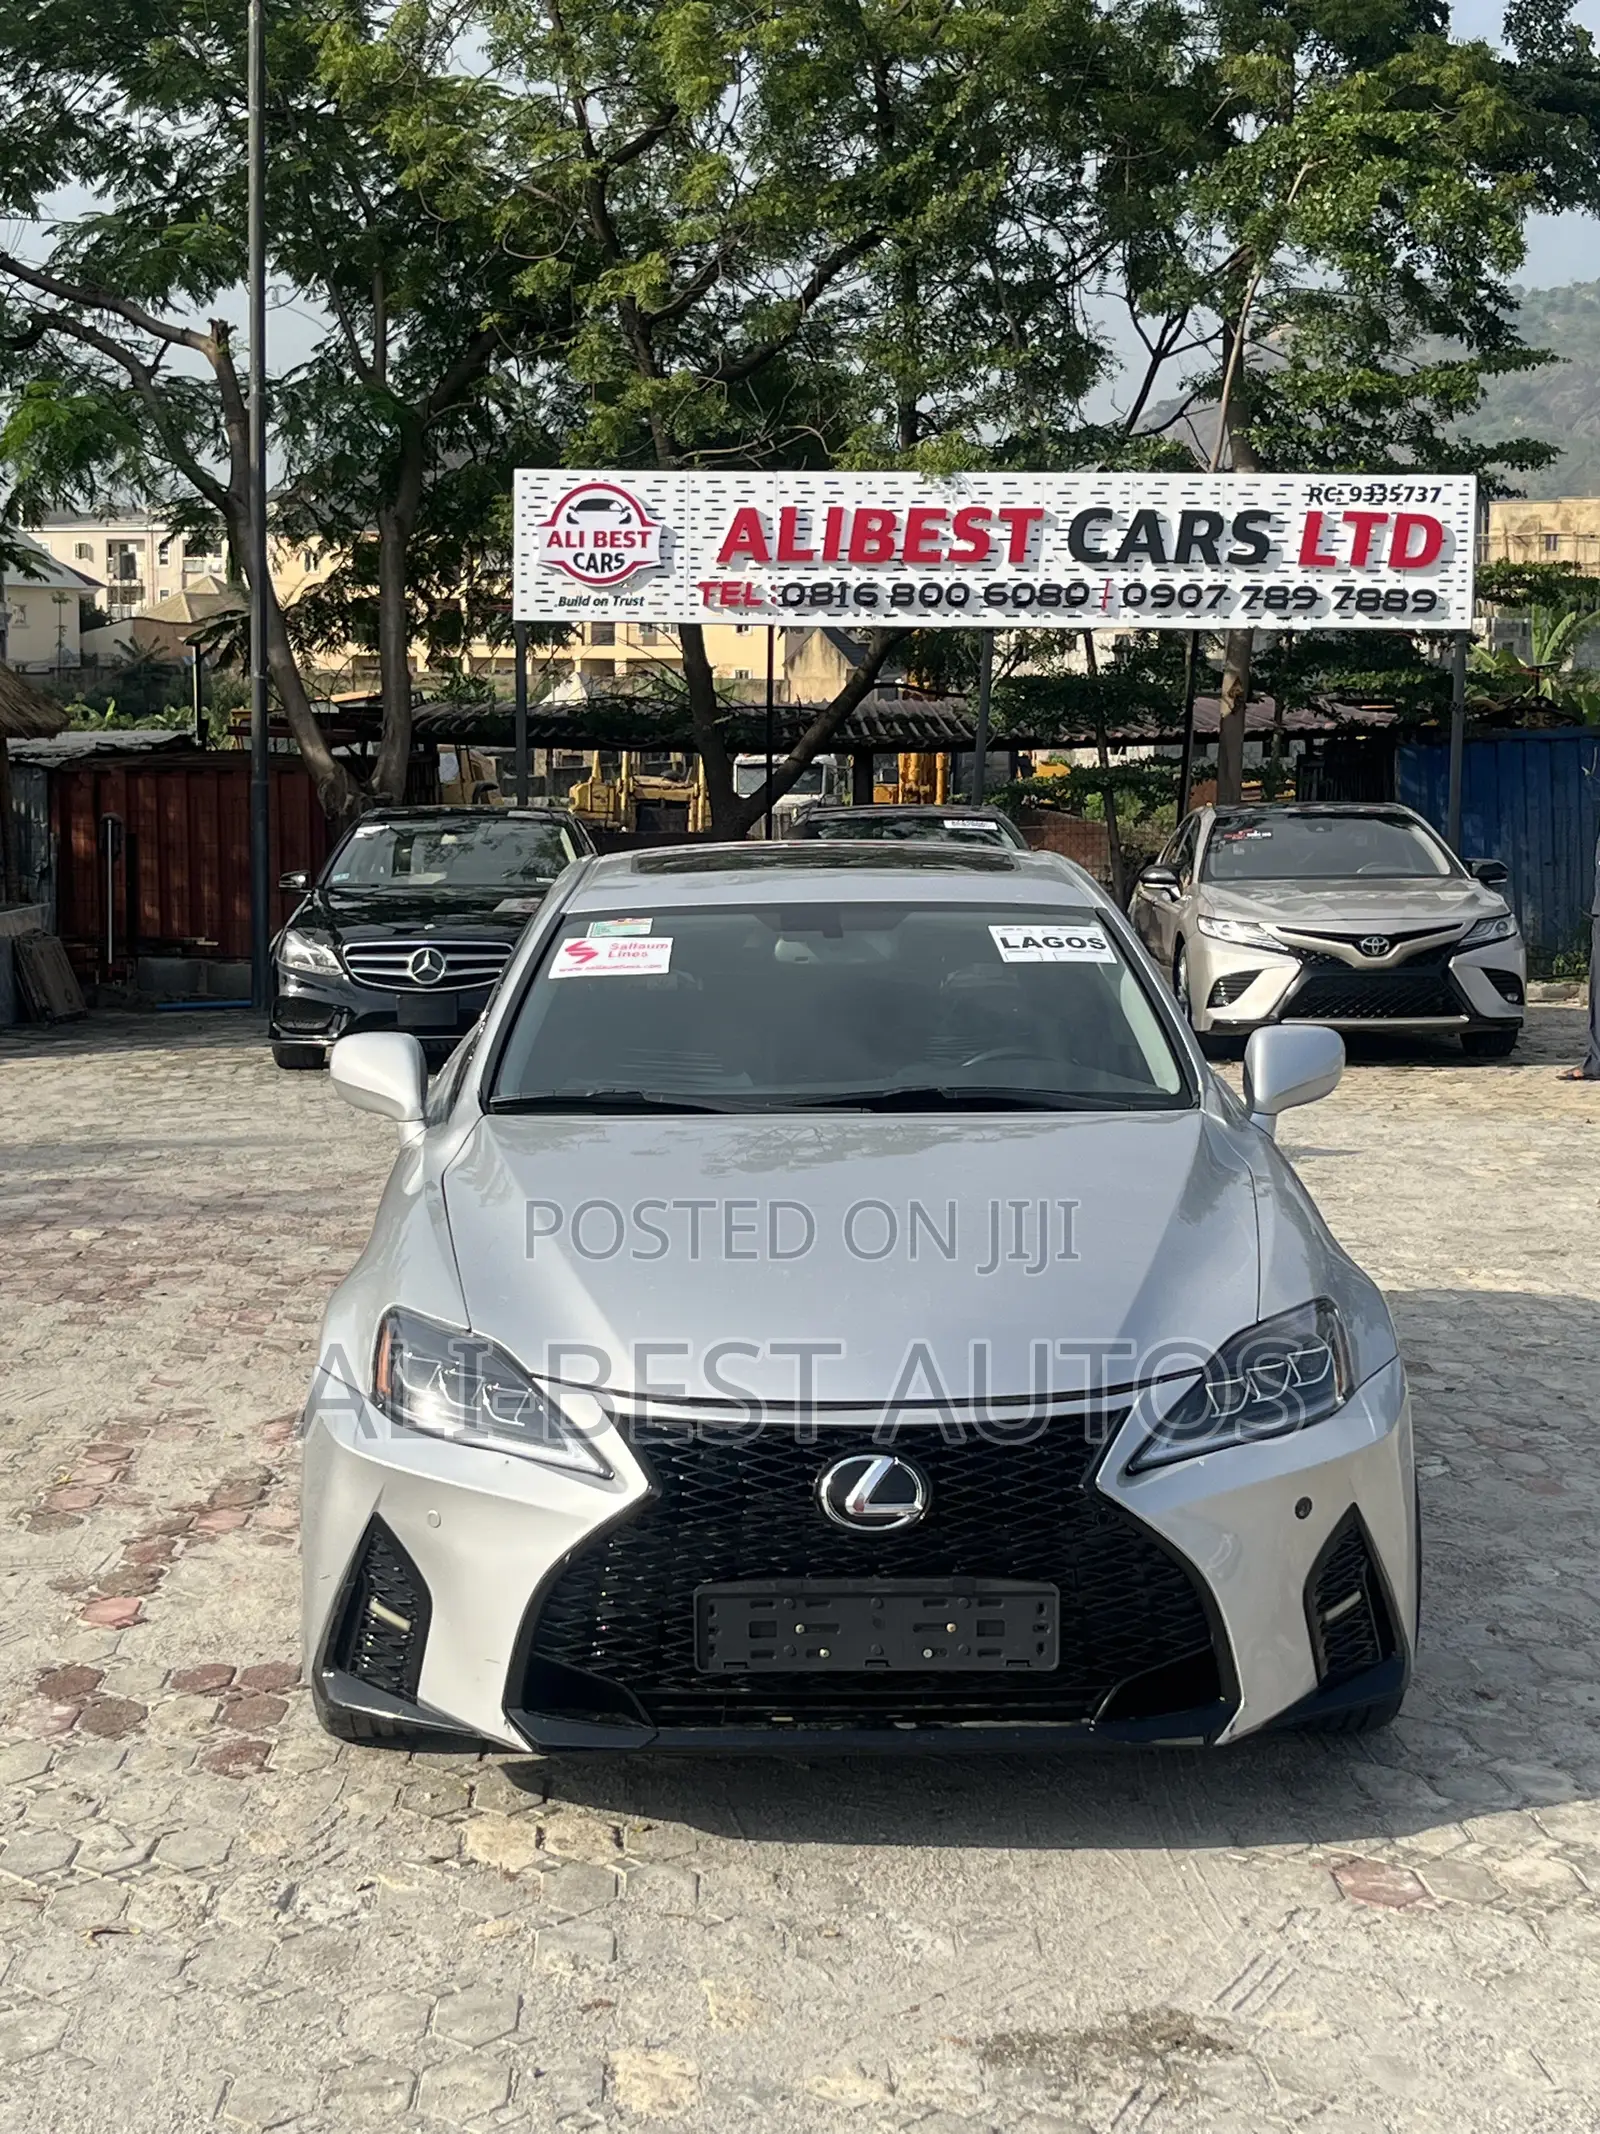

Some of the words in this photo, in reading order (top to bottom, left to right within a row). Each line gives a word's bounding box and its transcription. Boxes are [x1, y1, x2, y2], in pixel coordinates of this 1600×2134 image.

[1349, 486, 1442, 503] 9335737
[546, 530, 585, 549] ALI
[593, 530, 652, 549] BEST
[716, 506, 1044, 563] ALIBEST
[1068, 507, 1271, 565] CARS
[1298, 511, 1444, 568] LTD
[572, 552, 626, 574] CARS
[558, 596, 591, 607] Build
[594, 598, 609, 607] on
[613, 596, 645, 607] Trust
[780, 581, 880, 607] 0816
[890, 582, 970, 607] 800
[983, 582, 1091, 607] 6080
[1122, 582, 1228, 609] 0907
[1241, 585, 1318, 611] 789
[1331, 586, 1438, 613] 7889
[1000, 936, 1107, 950] LAGOS
